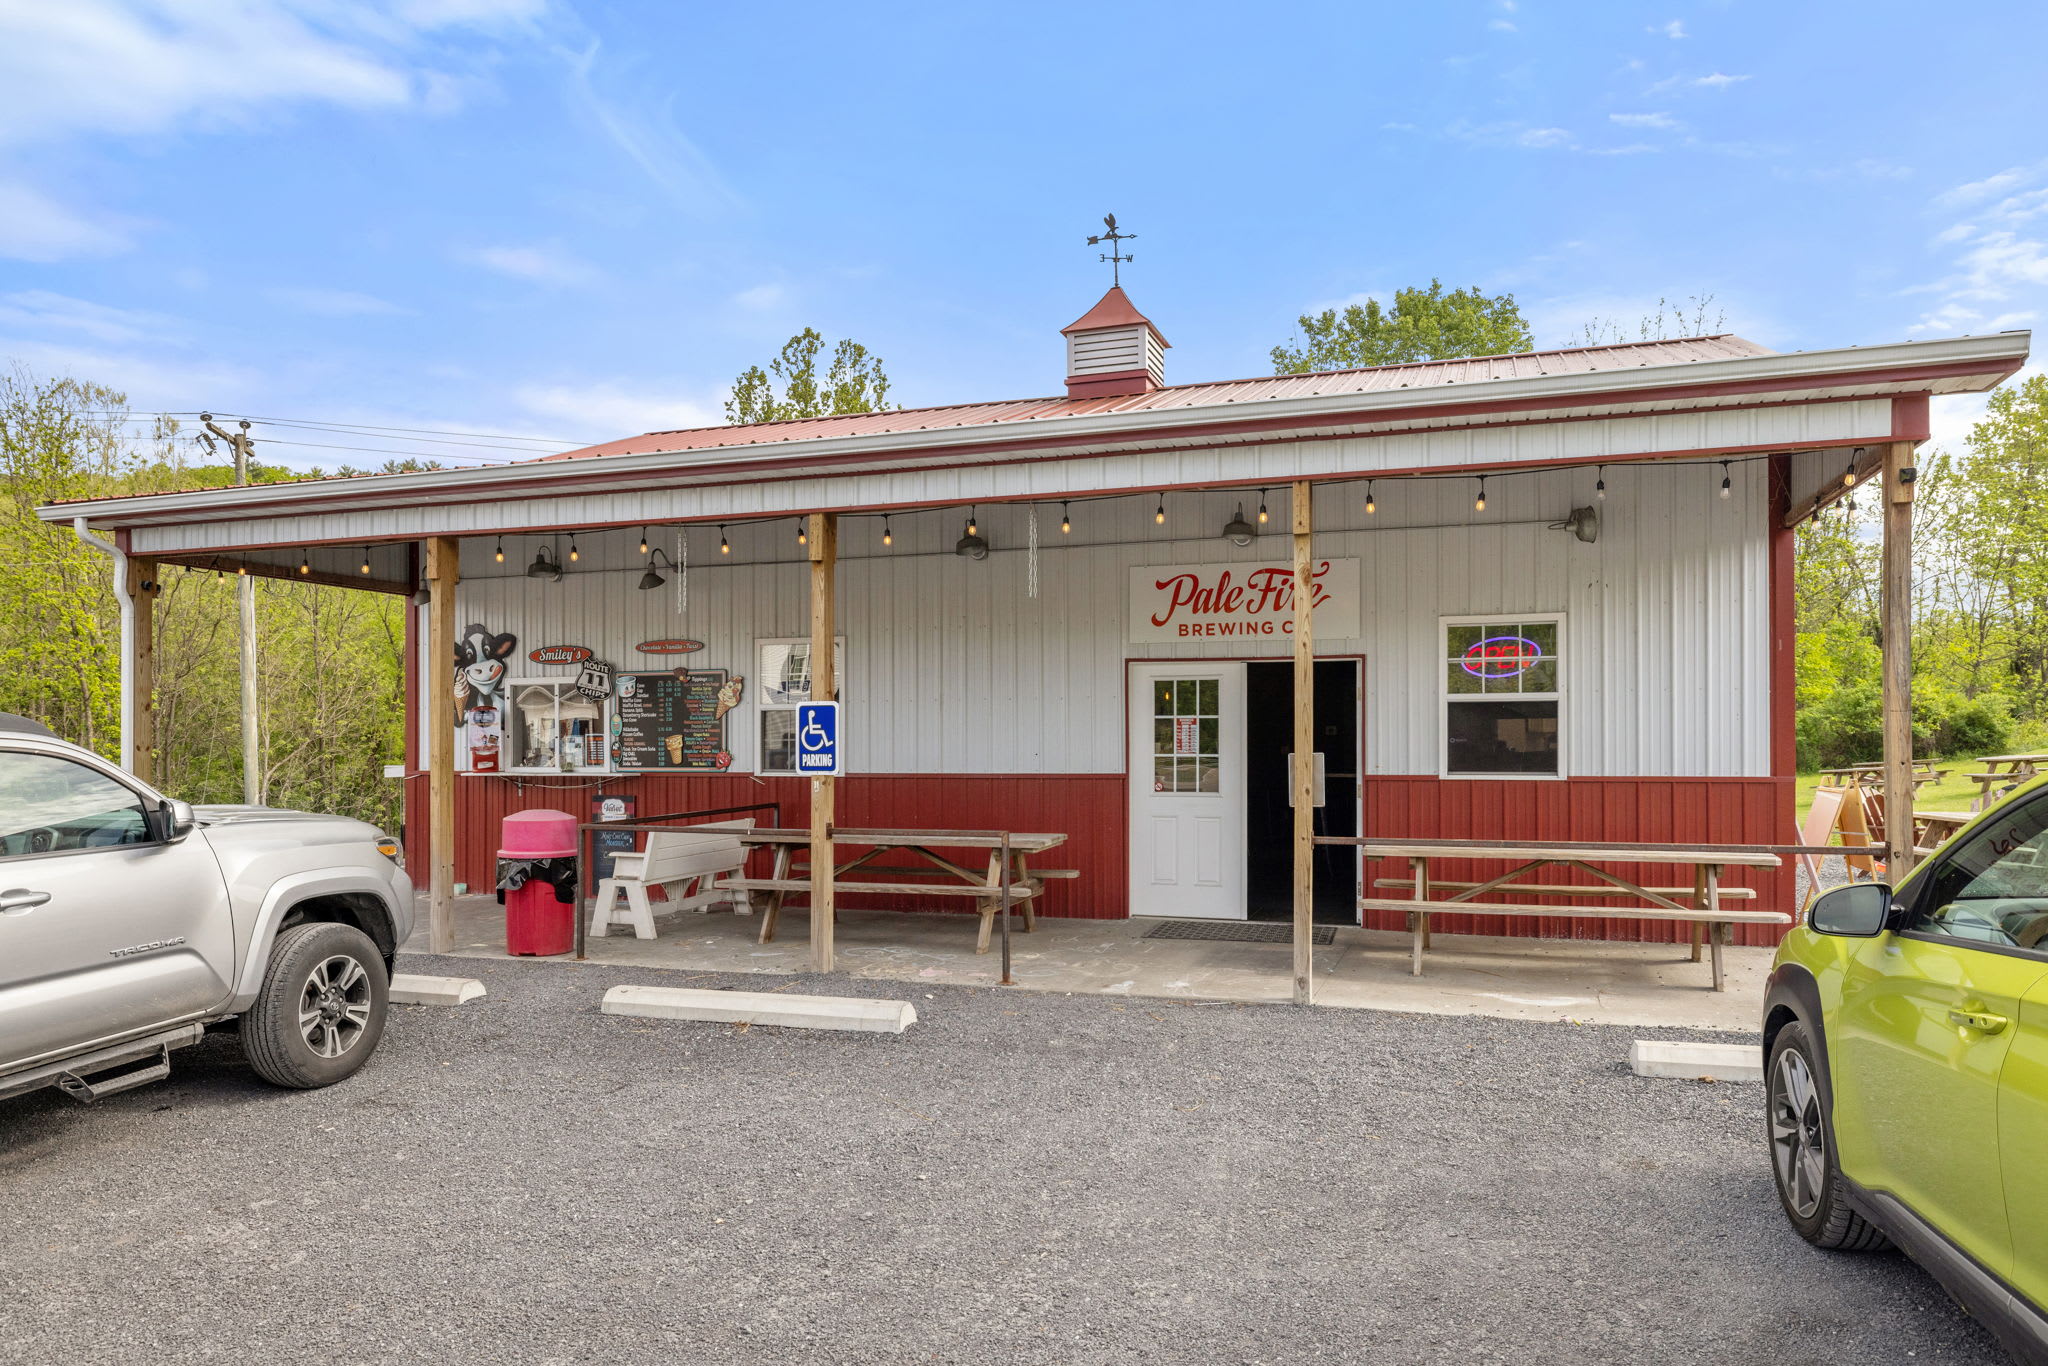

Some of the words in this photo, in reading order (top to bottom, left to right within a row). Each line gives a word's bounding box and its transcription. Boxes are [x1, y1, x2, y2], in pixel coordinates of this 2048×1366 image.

[1151, 570, 1244, 627] Pale
[1178, 621, 1274, 637] BREWING
[539, 648, 582, 664] Smiley's
[1465, 644, 1535, 670] OPEN
[584, 661, 609, 674] ROUTE
[585, 672, 605, 687] 11
[580, 687, 605, 699] CHIPS
[802, 753, 832, 767] PARKING
[110, 937, 186, 957] TACOMA
